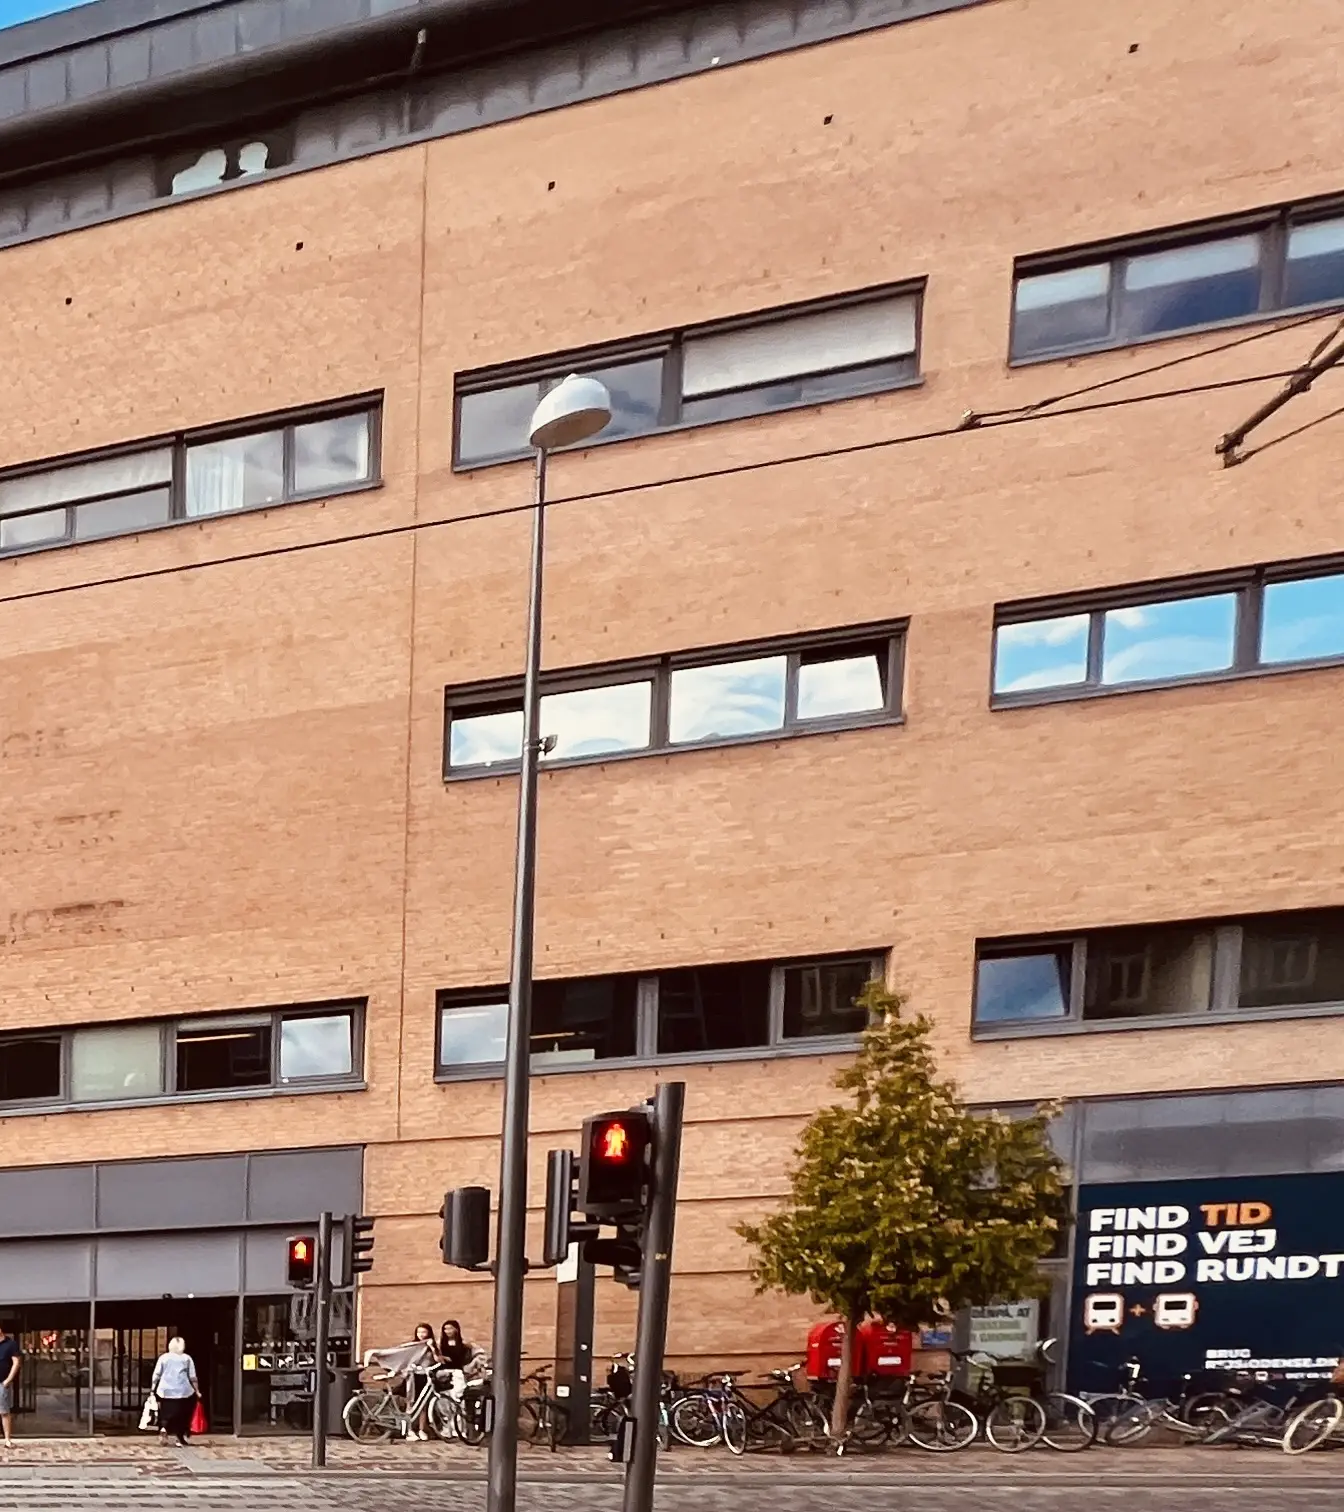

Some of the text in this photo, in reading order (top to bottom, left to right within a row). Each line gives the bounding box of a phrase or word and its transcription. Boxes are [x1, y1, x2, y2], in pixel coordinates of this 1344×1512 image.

[1089, 1202, 1272, 1231] FIND TID
[1088, 1229, 1277, 1258] FIND VEJ
[1086, 1254, 1344, 1286] FIND RUNDT
